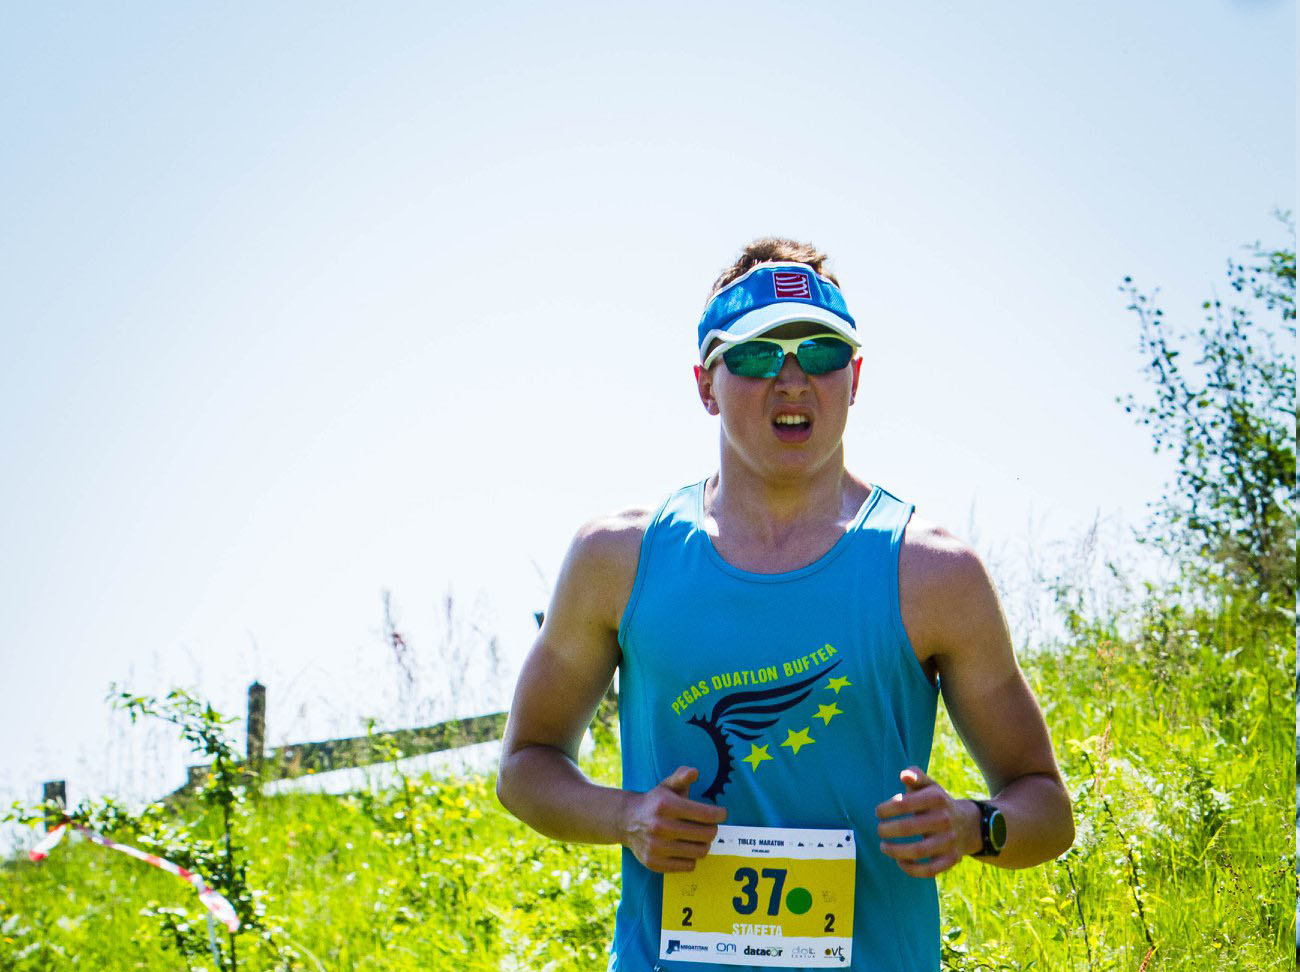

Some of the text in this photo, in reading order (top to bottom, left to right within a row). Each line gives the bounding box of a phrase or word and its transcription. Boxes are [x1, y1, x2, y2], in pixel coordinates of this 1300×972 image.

[671, 643, 838, 716] PEGAS DUATLON BUFTEA
[732, 867, 788, 916] 37
[682, 907, 693, 926] 2
[824, 914, 835, 932] 2
[732, 923, 783, 937] STAFETA
